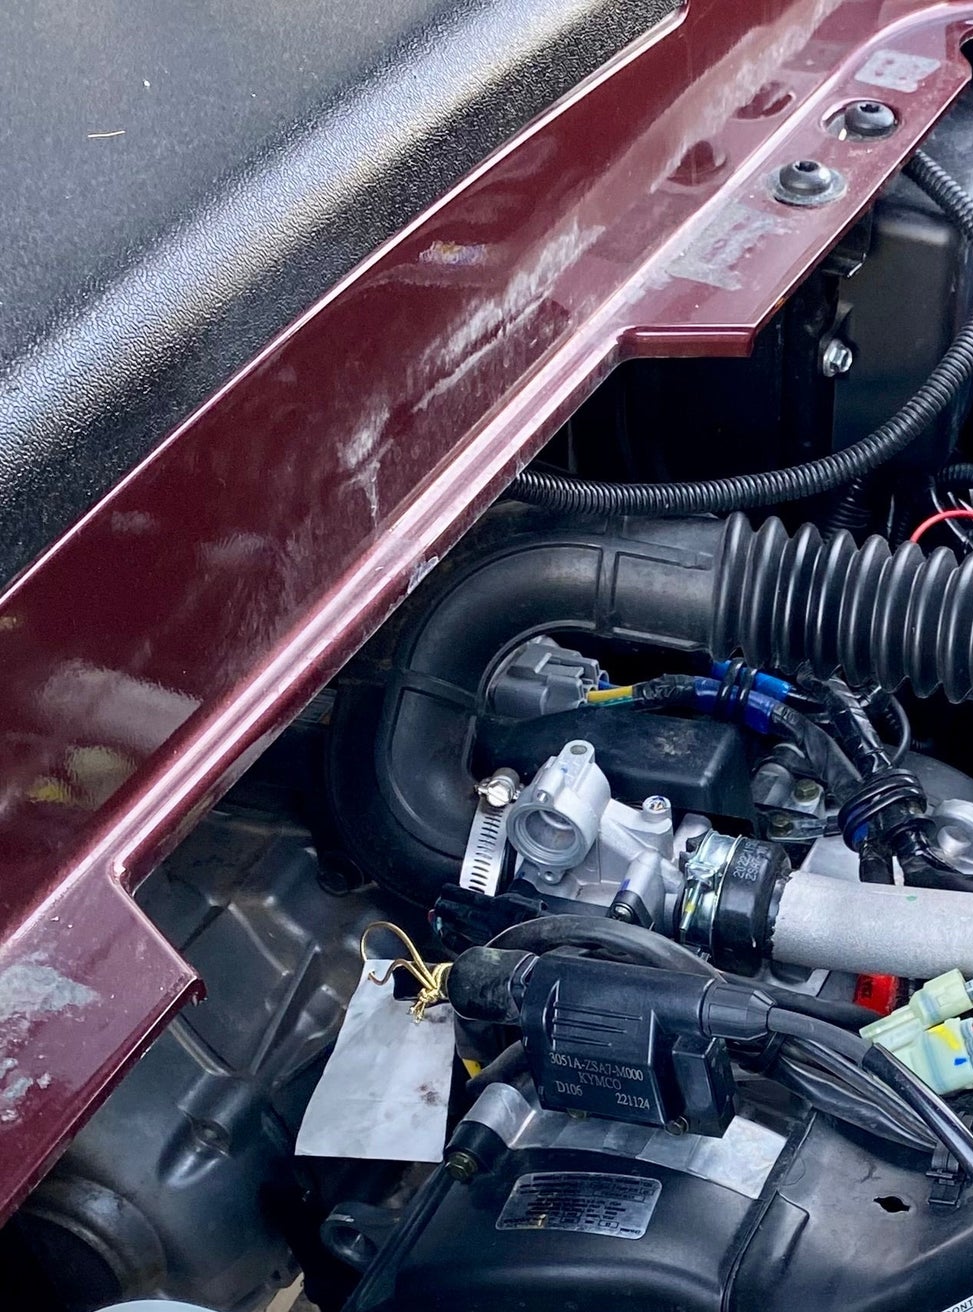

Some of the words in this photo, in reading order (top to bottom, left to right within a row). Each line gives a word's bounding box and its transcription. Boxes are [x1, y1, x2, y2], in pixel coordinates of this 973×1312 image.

[549, 1052, 644, 1081] 3051A-ZSA7-M000
[577, 1071, 622, 1090] KYMCO
[615, 1092, 650, 1110] 22112A
